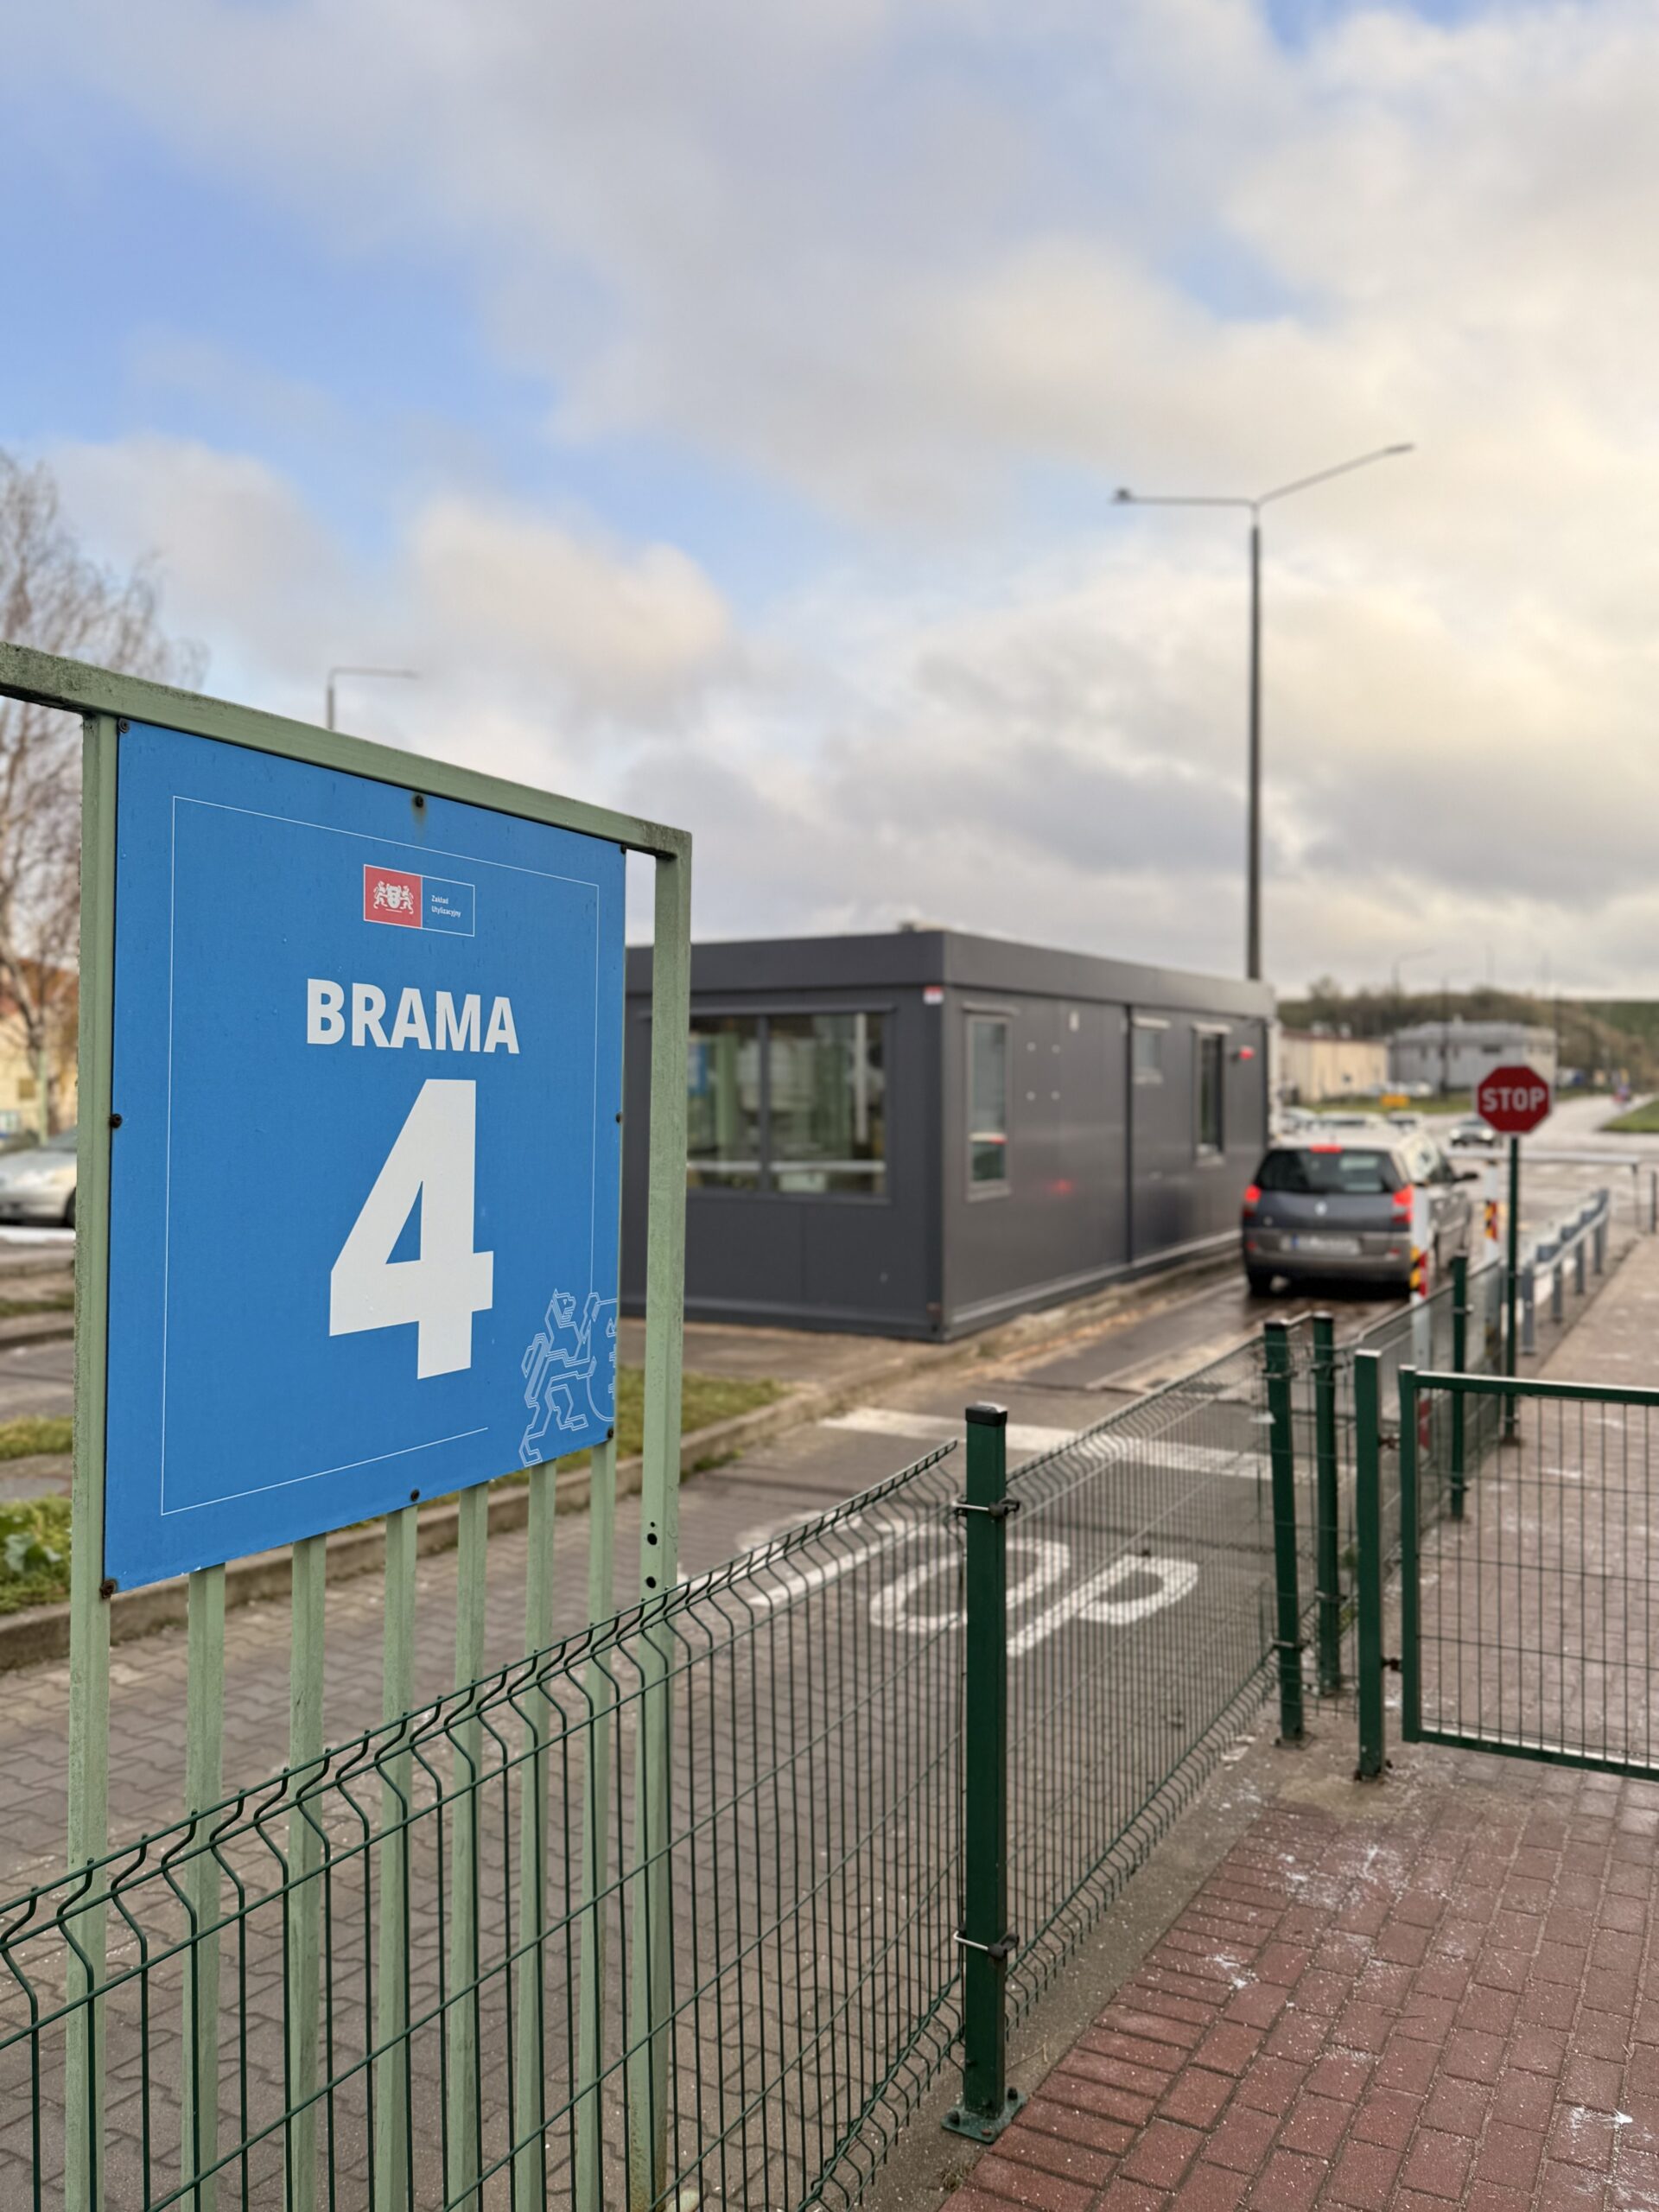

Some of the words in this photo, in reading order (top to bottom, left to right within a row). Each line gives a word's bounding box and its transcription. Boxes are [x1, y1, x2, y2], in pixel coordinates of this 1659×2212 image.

[308, 978, 520, 1054] BRAMA
[1482, 1086, 1546, 1112] STOP
[329, 1079, 494, 1380] 4
